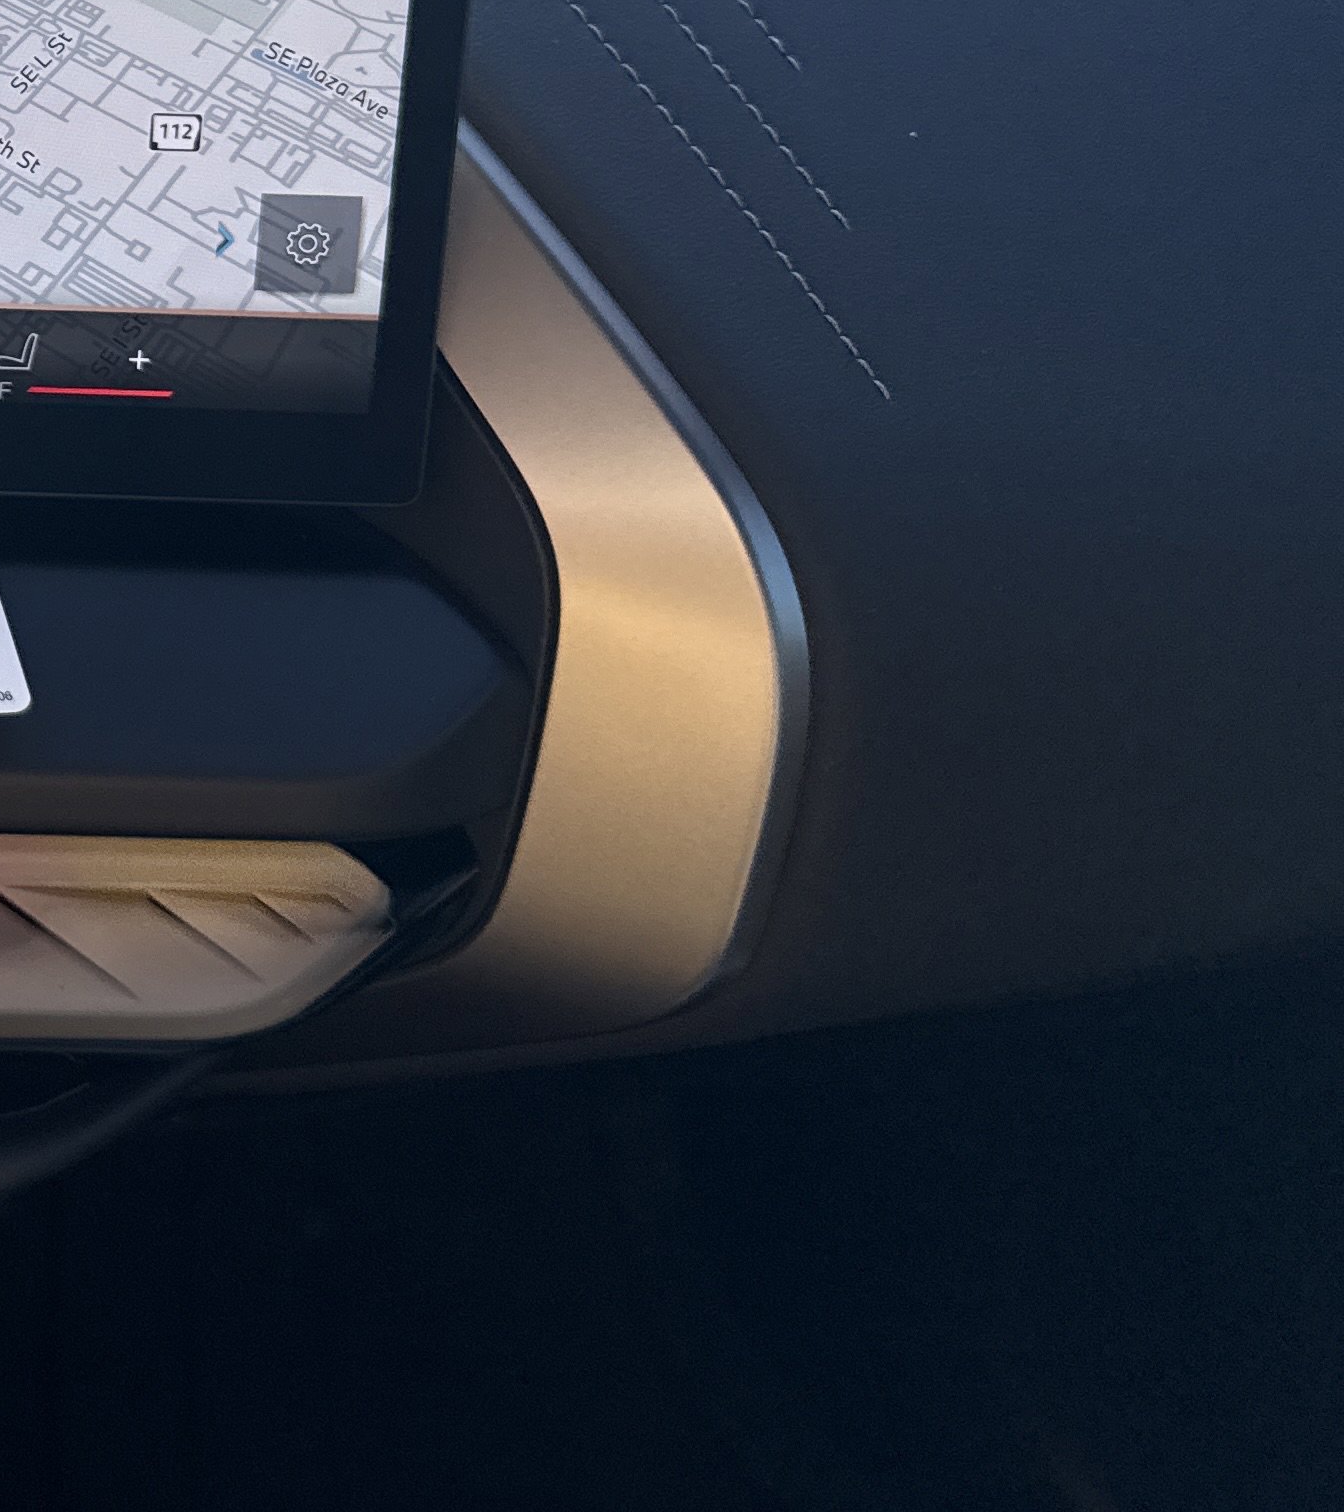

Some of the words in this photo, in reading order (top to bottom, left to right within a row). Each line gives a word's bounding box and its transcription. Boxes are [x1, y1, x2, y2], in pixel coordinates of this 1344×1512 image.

[10, 64, 40, 94] SE
[33, 54, 53, 70] L
[47, 32, 73, 55] St
[264, 41, 296, 68] SE
[295, 55, 349, 97] Plaza
[350, 89, 389, 120] Ave
[160, 123, 193, 140] 112
[16, 150, 41, 174] St
